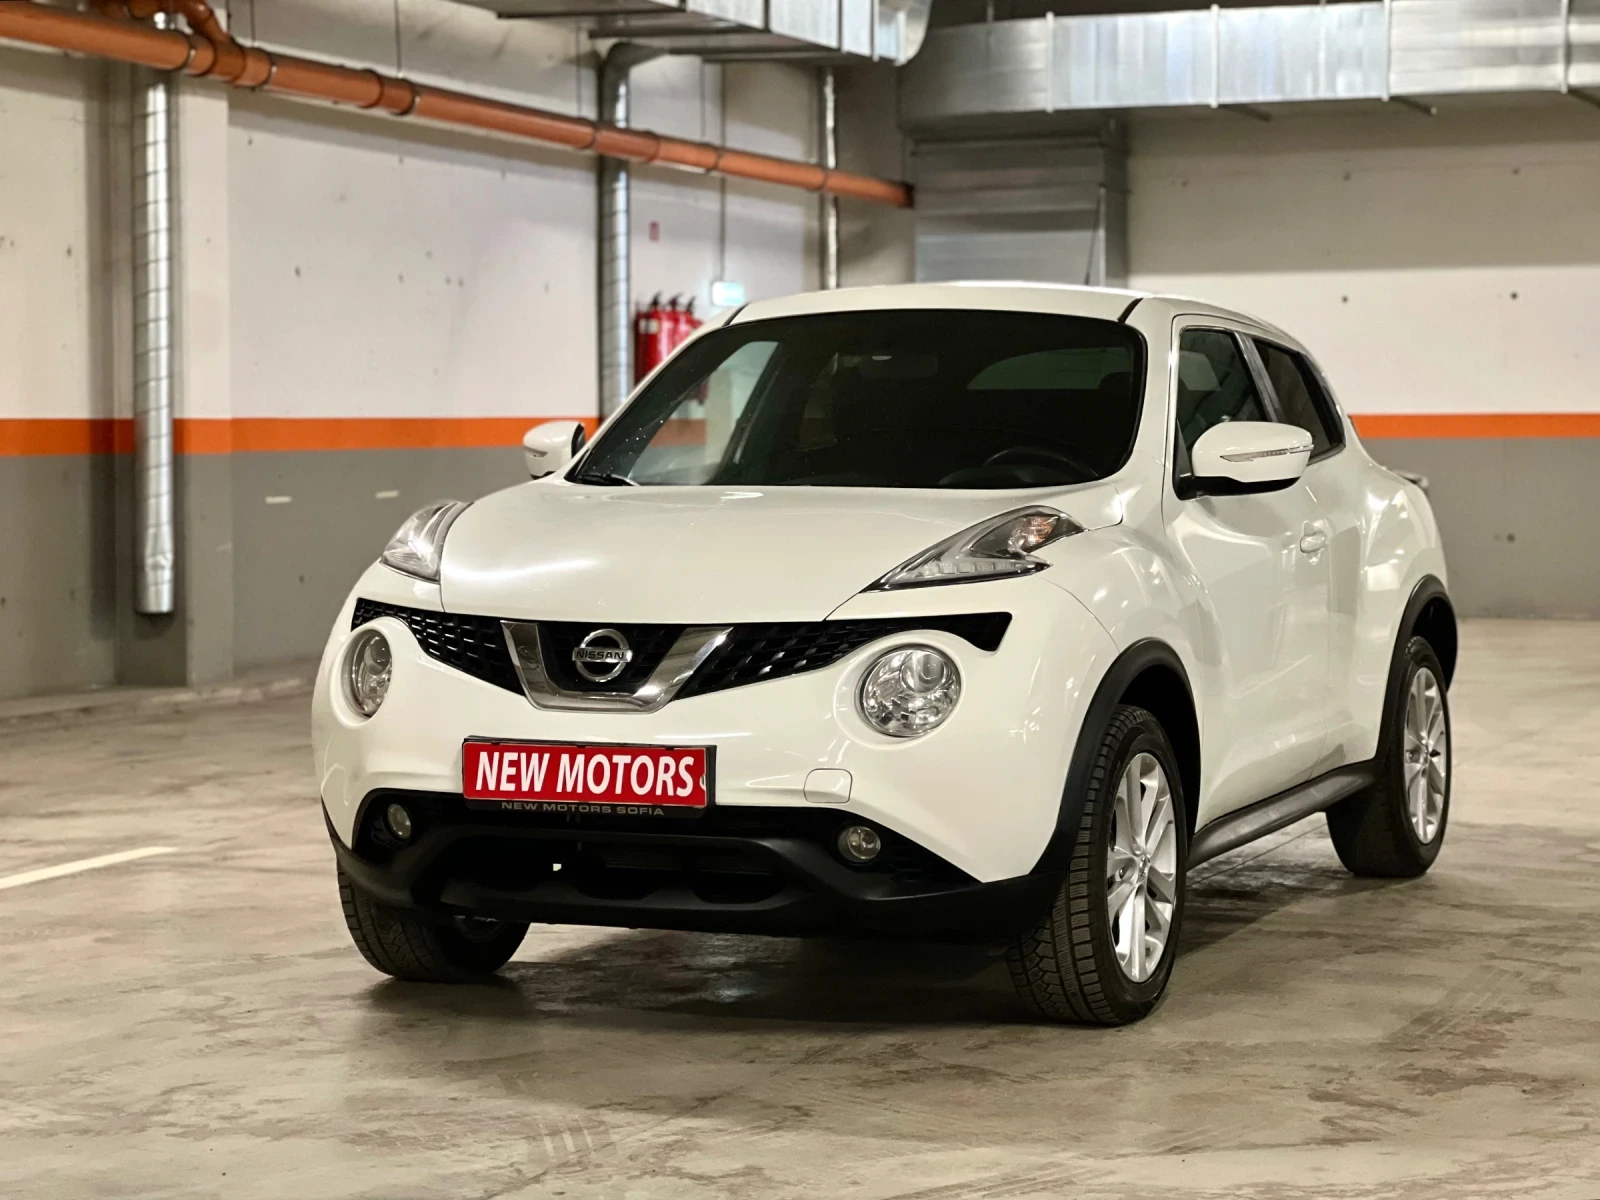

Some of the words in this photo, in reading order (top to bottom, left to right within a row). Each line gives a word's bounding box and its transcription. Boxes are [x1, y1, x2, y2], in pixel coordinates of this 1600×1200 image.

[576, 650, 624, 660] NISSAN
[475, 751, 550, 792] NEW
[556, 753, 695, 797] MOTORS
[501, 801, 539, 810] NEW
[543, 802, 612, 814] MOTORS
[616, 806, 664, 816] SOFIA
